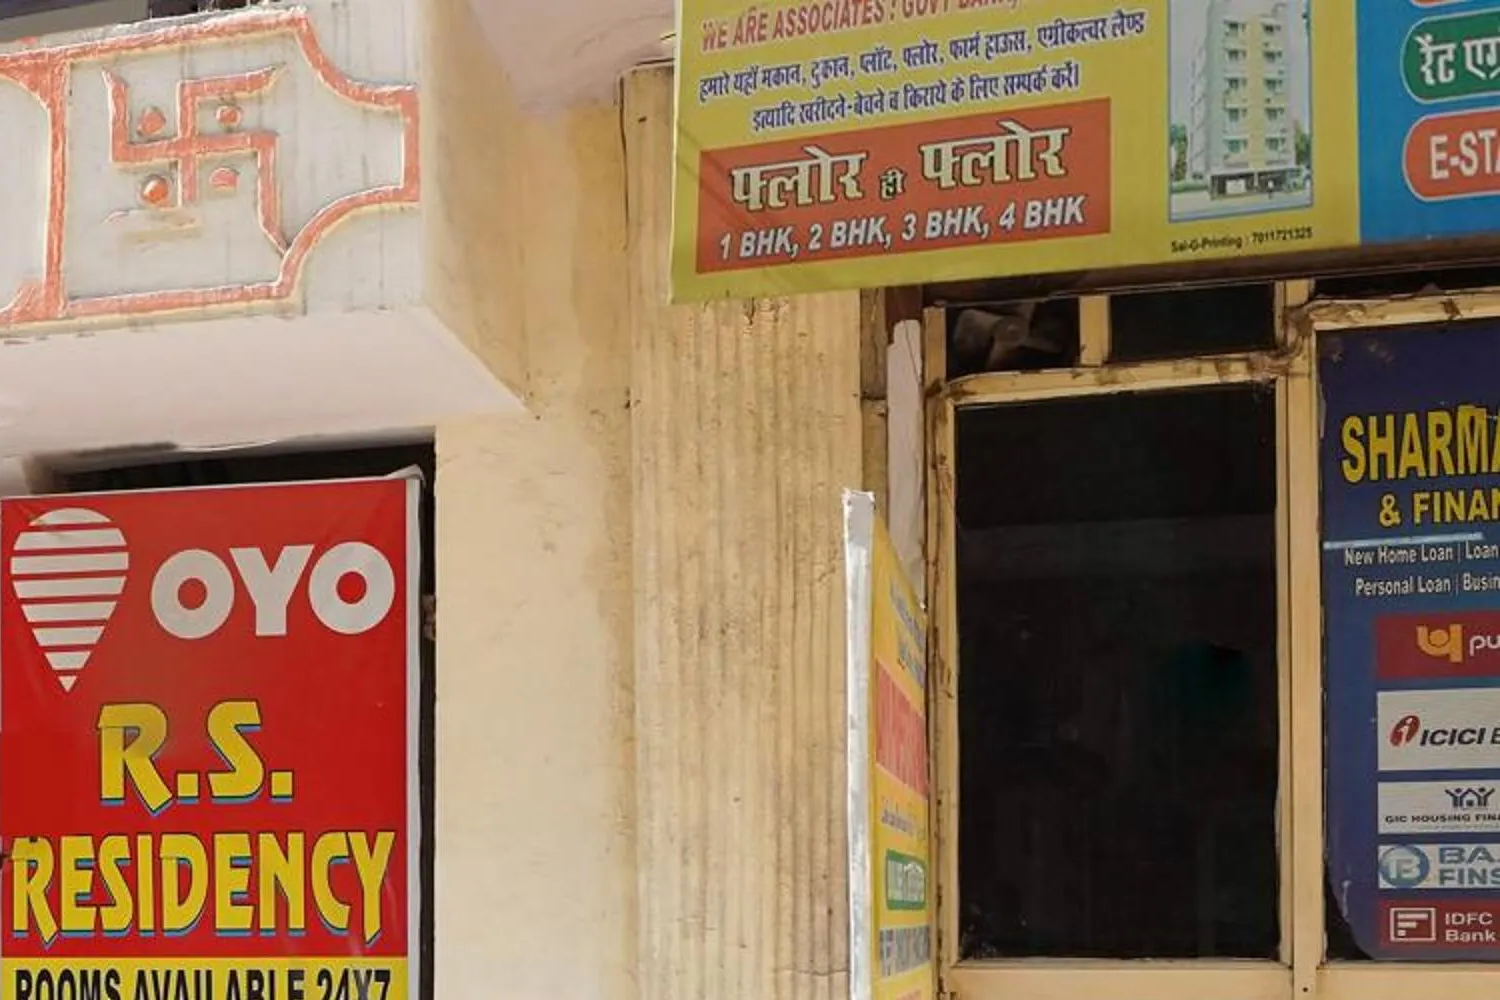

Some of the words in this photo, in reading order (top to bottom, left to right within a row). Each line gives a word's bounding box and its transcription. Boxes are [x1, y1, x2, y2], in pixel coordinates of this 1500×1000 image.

[702, 18, 727, 50] WE
[732, 10, 768, 46] ARE
[772, 0, 884, 40] ASSOCIATES
[729, 145, 867, 212] फ्लोर
[878, 166, 904, 201] ही
[918, 120, 1072, 190] फ्लोर
[1430, 128, 1500, 180] E-ST
[719, 233, 731, 259] 1
[739, 227, 799, 266] BHK,
[809, 223, 822, 250] 2
[829, 216, 892, 254] BHK,
[902, 213, 916, 241] 3
[925, 208, 989, 240] BHK,
[999, 202, 1015, 230] 4
[1024, 195, 1085, 228] BHK
[1379, 494, 1401, 528] &
[1344, 547, 1373, 566] New
[1377, 545, 1417, 564] Home
[1421, 543, 1453, 562] Loan
[1465, 540, 1500, 560] Loan
[150, 540, 396, 640] OYO
[1356, 576, 1413, 597] Personal
[1417, 574, 1451, 594] Loan
[96, 698, 295, 817] R.S.
[1420, 728, 1486, 746] ICICI
[1385, 815, 1407, 825] GIC
[1411, 813, 1470, 824] HOUSING
[10, 830, 396, 949] RESIDENCY
[1445, 912, 1493, 926] IDFC
[1445, 928, 1496, 943] Bank
